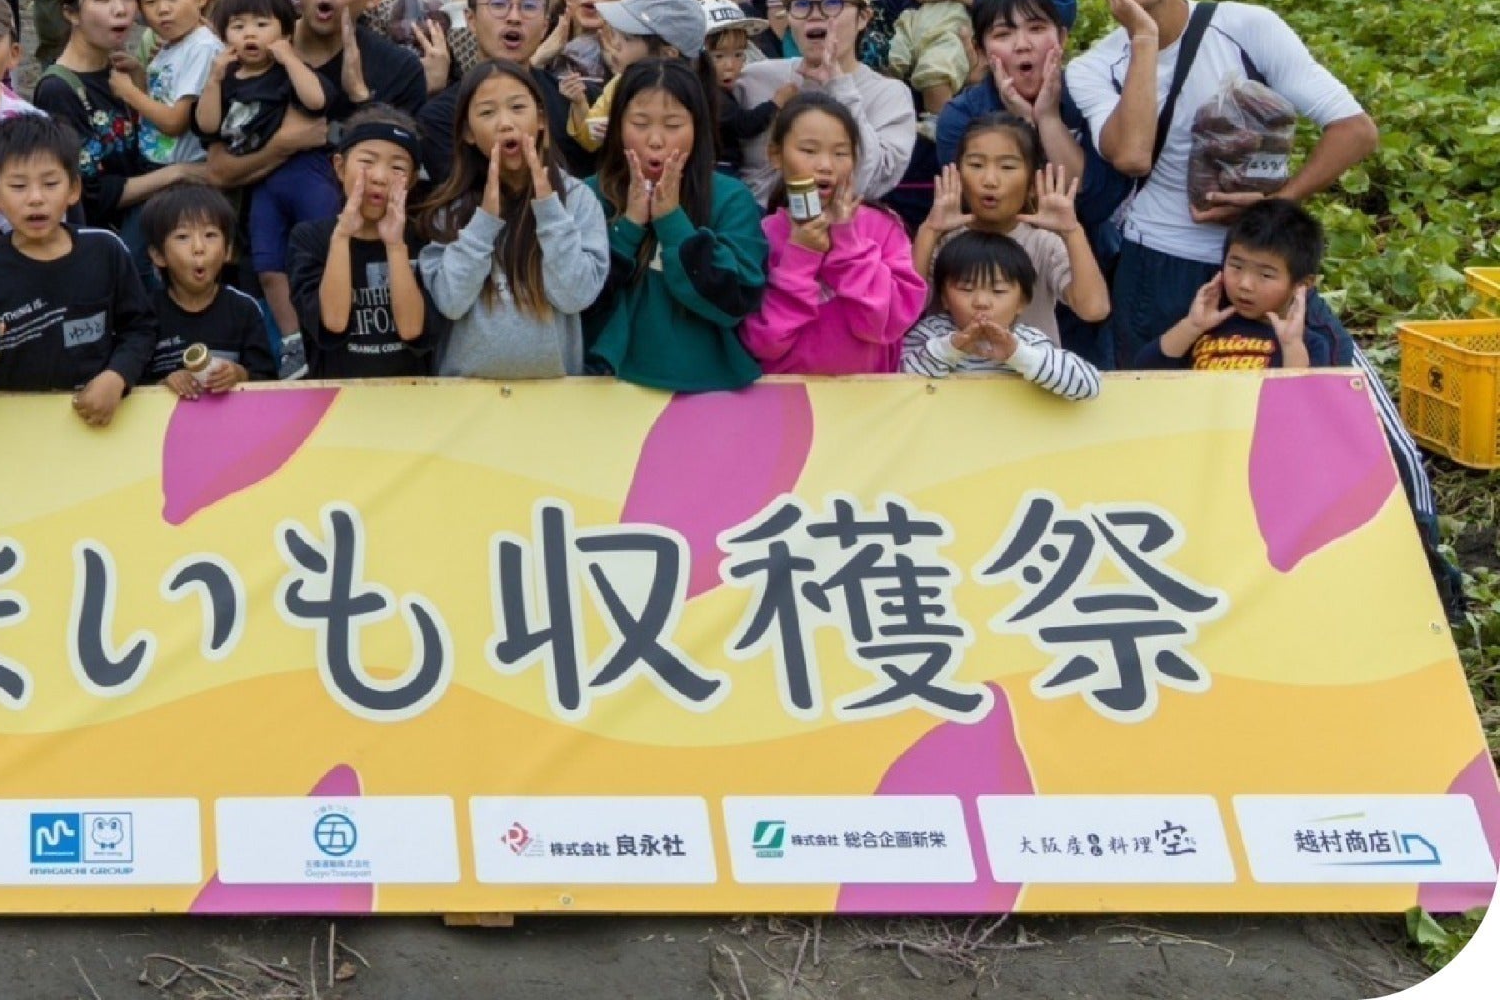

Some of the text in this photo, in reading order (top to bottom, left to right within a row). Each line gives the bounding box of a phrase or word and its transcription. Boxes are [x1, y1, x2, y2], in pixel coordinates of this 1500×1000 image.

[1193, 334, 1274, 356] Curious
[550, 841, 611, 857] 株式会社
[615, 834, 687, 857] 良永社
[790, 830, 948, 849] 株式会社 総合企画新栄
[1293, 829, 1393, 854] 越村商店
[89, 866, 135, 876] GROUP
